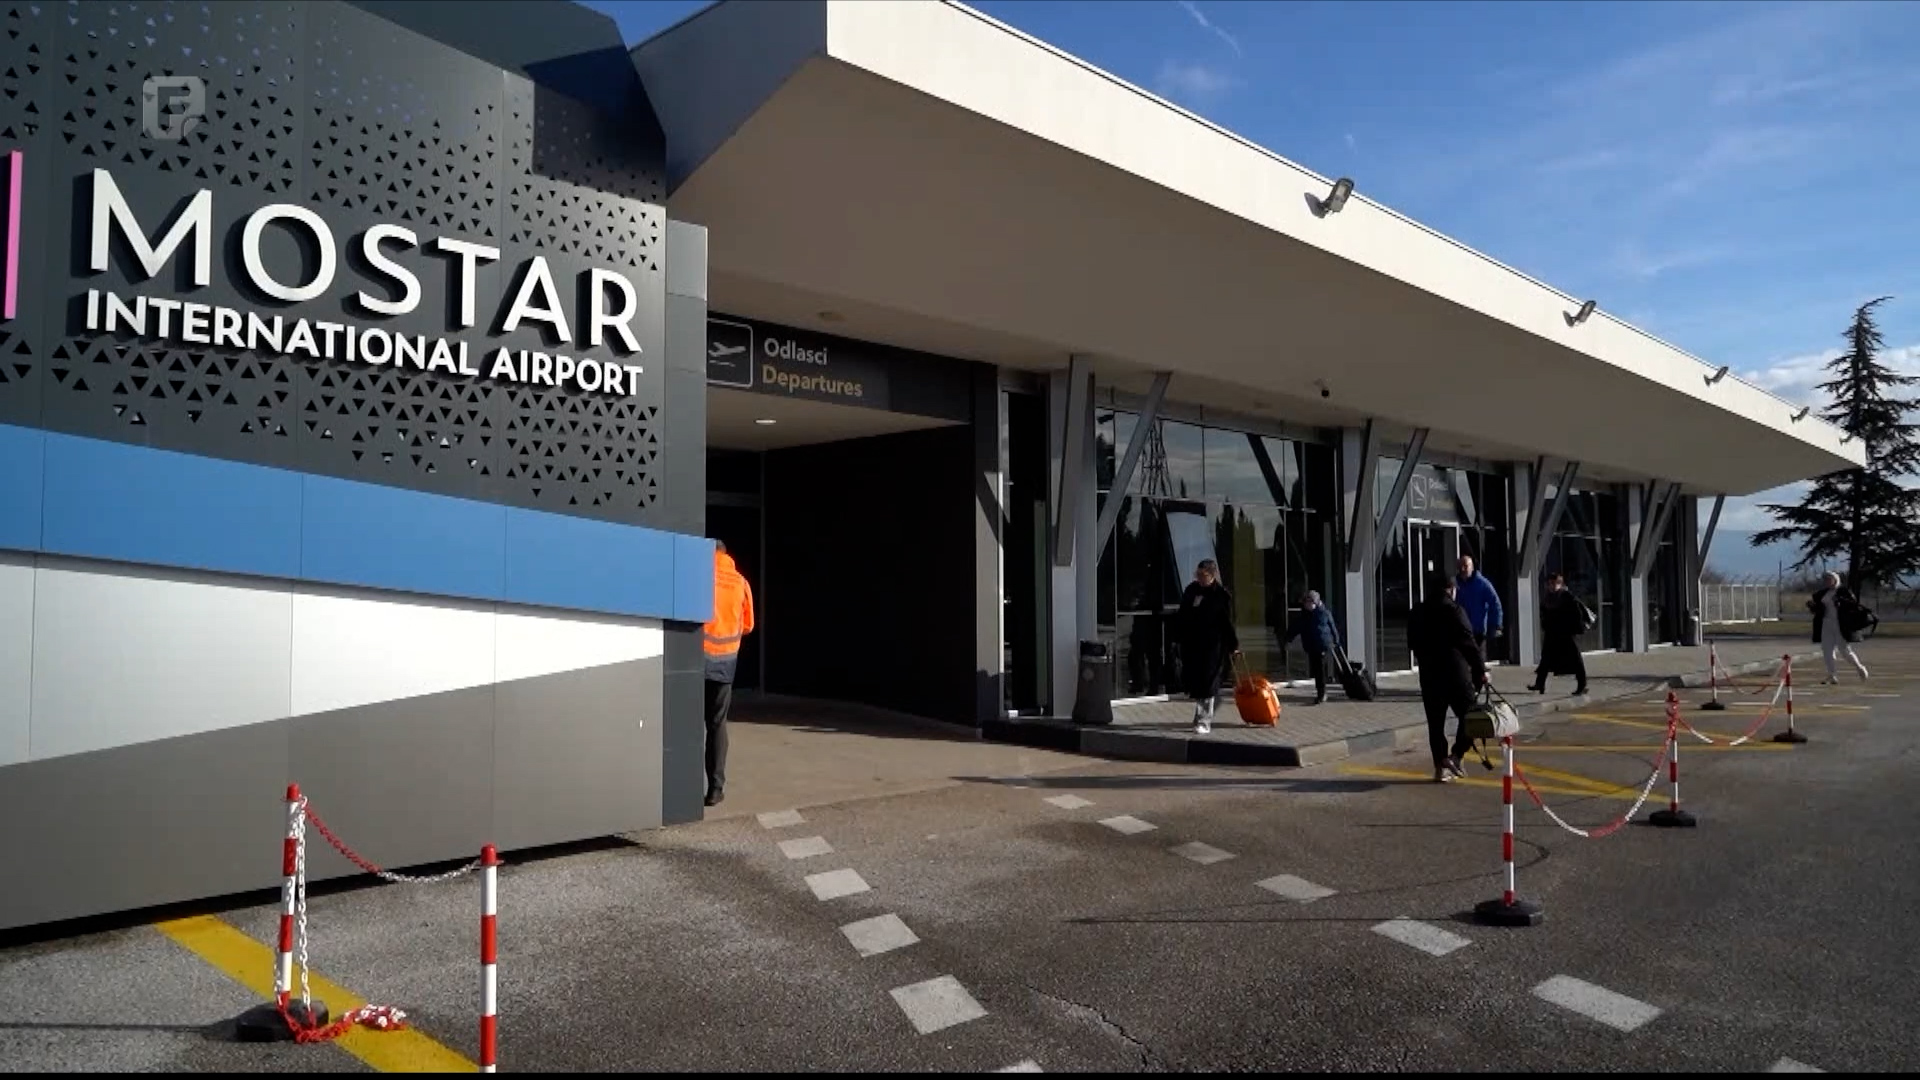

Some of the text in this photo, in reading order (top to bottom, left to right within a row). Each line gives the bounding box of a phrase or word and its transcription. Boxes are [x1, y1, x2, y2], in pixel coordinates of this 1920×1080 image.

[91, 168, 644, 353] MOSTAR
[87, 289, 644, 396] INTERNATIONAL AIRPORT
[763, 338, 828, 365] Odlasci
[762, 366, 863, 396] Departures
